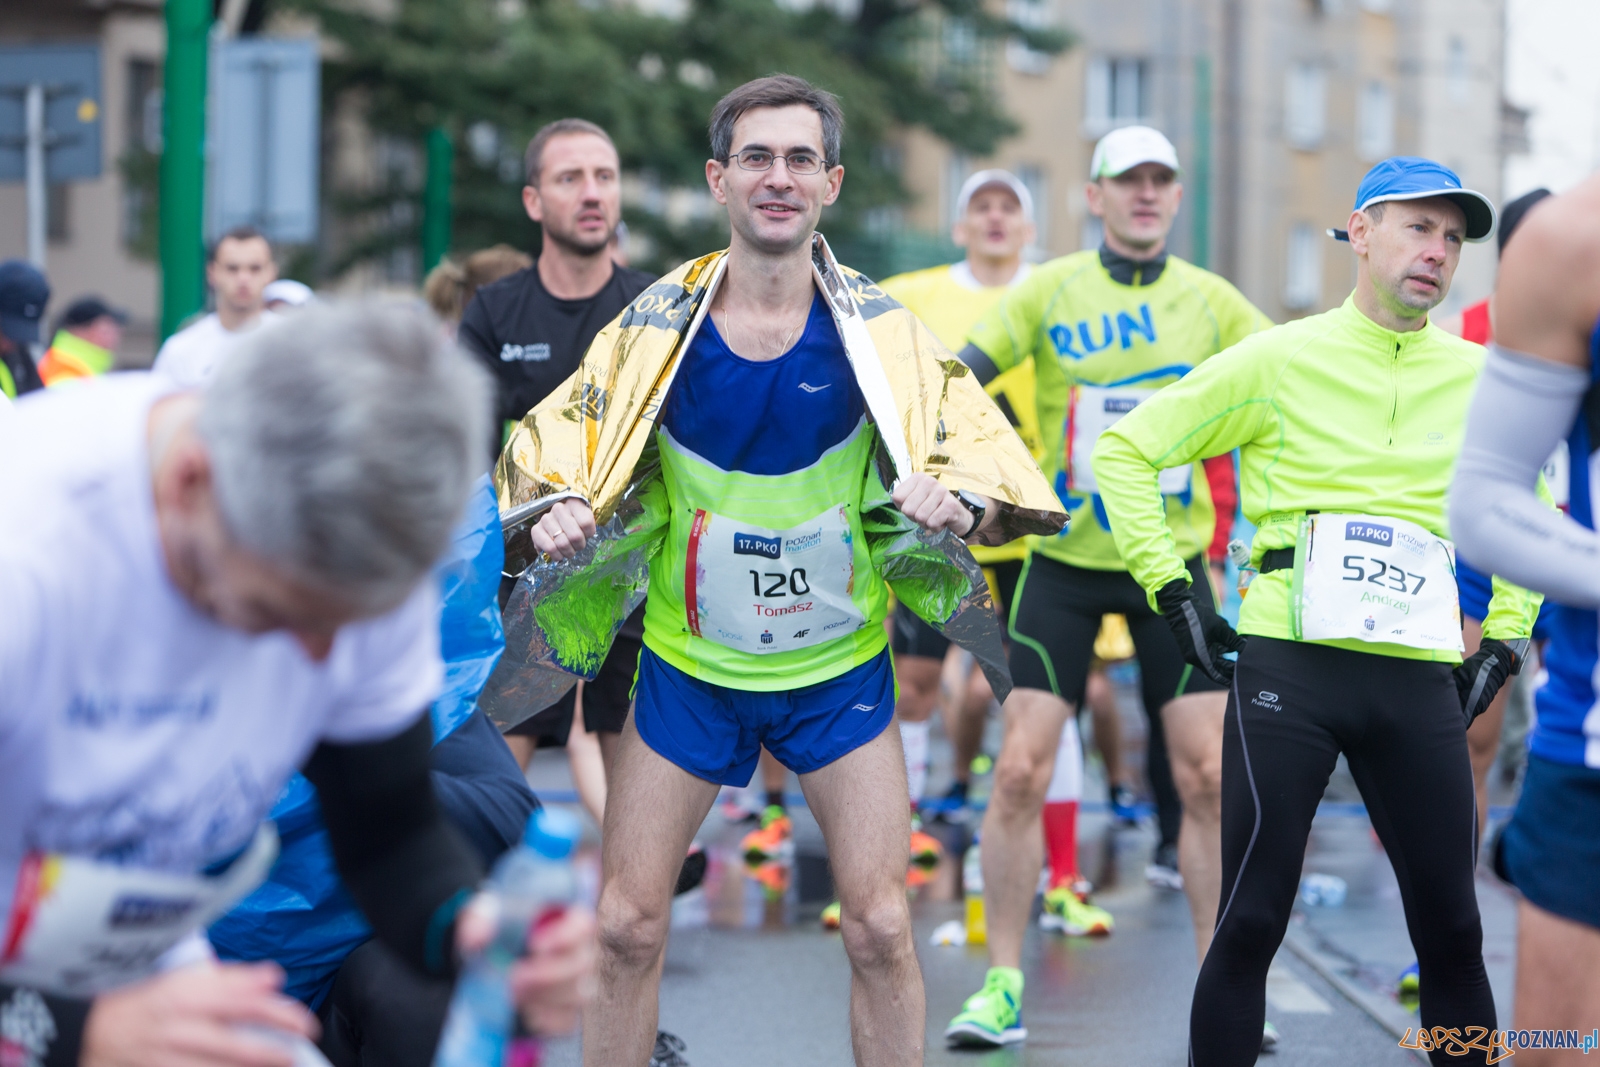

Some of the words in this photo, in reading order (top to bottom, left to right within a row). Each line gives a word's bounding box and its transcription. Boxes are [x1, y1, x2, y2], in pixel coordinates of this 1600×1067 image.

[1048, 303, 1157, 361] RUN
[1350, 526, 1364, 537] 17.
[1366, 527, 1390, 541] PKO
[738, 539, 753, 550] 17.
[755, 540, 778, 554] PKO
[785, 537, 822, 553] maraton
[1396, 540, 1425, 557] maraton
[749, 568, 810, 598] 120
[1342, 555, 1427, 595] 5237
[753, 601, 813, 617] Tomasz
[1360, 591, 1411, 615] Andrzej
